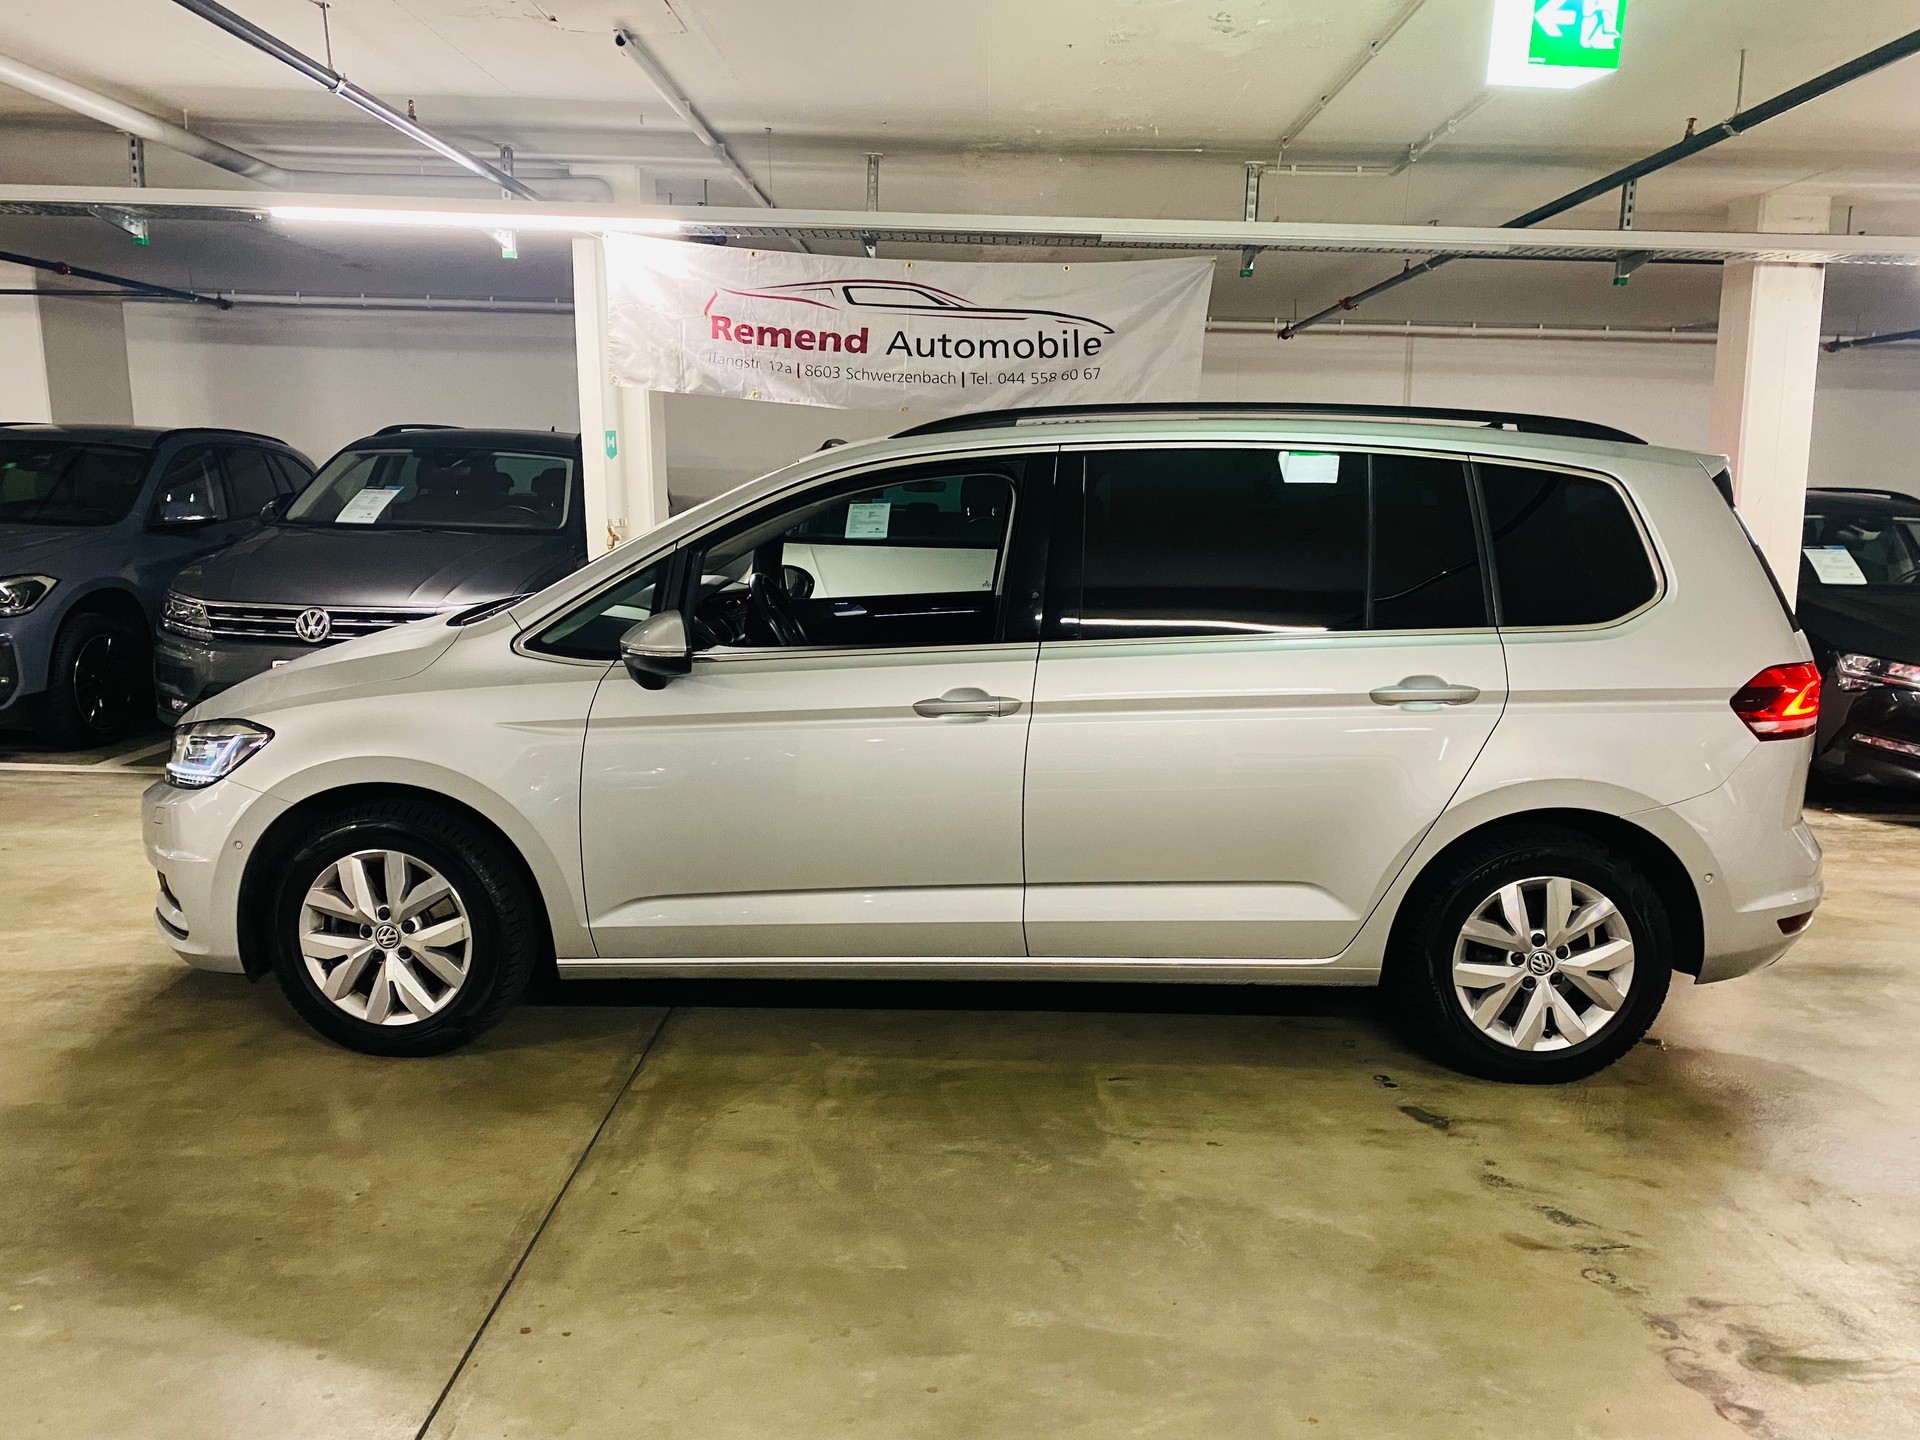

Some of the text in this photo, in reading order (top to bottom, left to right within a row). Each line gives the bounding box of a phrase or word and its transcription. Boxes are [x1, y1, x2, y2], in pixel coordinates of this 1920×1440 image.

[710, 315, 1102, 359] Remend Automobile
[769, 361, 793, 374] 12a
[804, 364, 841, 379] 8603
[845, 367, 957, 385] Schwerzenbach
[969, 372, 993, 385] Tel.
[997, 372, 1026, 385] 044
[1031, 372, 1057, 385] 558
[1061, 368, 1079, 381] 60
[1083, 367, 1101, 380] 67
